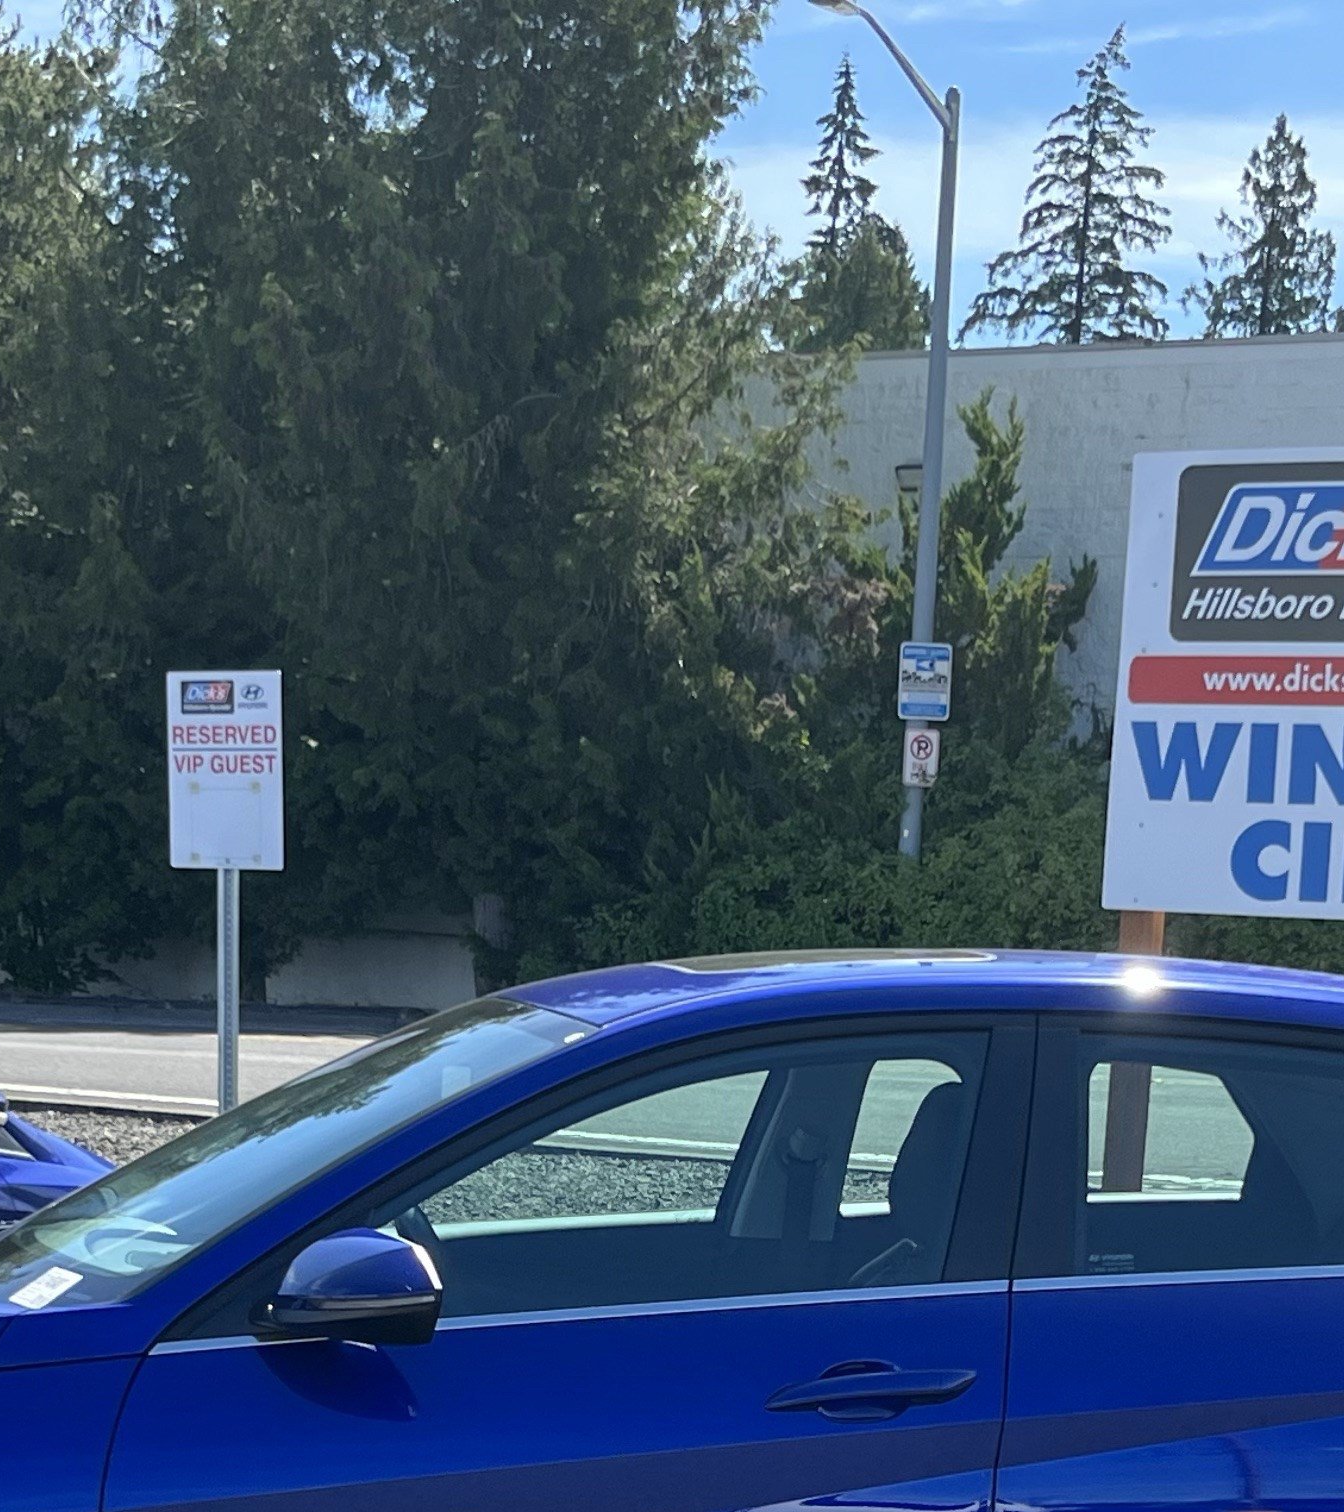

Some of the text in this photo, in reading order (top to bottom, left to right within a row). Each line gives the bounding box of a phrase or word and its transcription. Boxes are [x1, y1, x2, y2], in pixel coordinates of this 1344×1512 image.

[1181, 586, 1336, 621] Hillsboro
[171, 724, 278, 745] RESERVED
[174, 754, 277, 775] VIP GUEST
